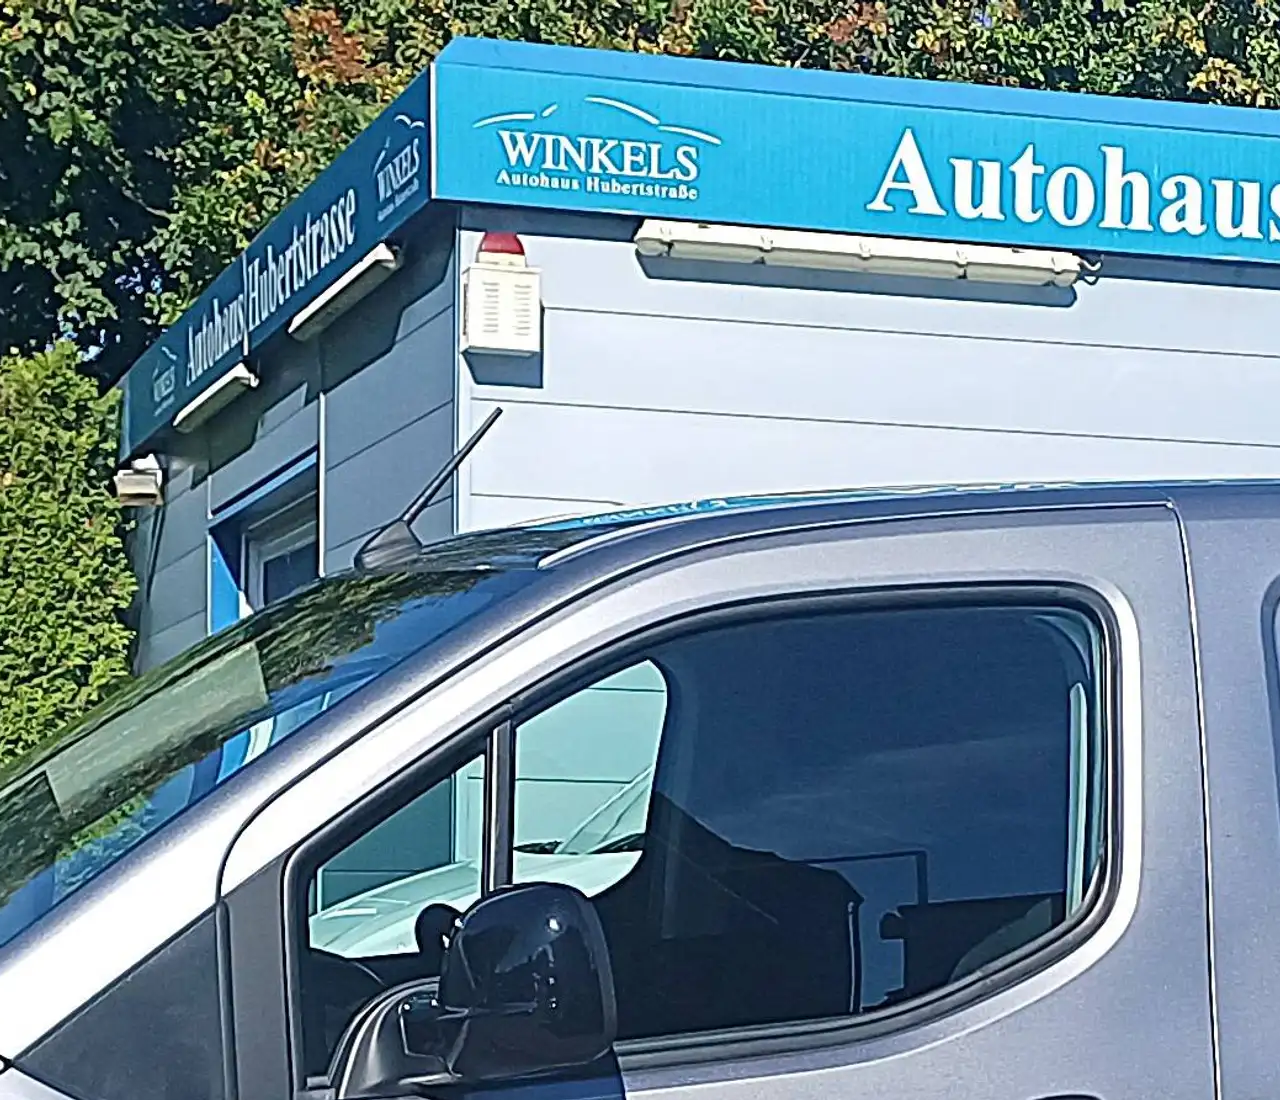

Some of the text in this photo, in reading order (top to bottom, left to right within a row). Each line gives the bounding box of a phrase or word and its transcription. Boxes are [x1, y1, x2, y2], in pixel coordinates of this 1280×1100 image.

[496, 168, 580, 191] Autohaus
[498, 129, 699, 182] WINKELS
[186, 188, 357, 388] Autohaus Hubertstrasse
